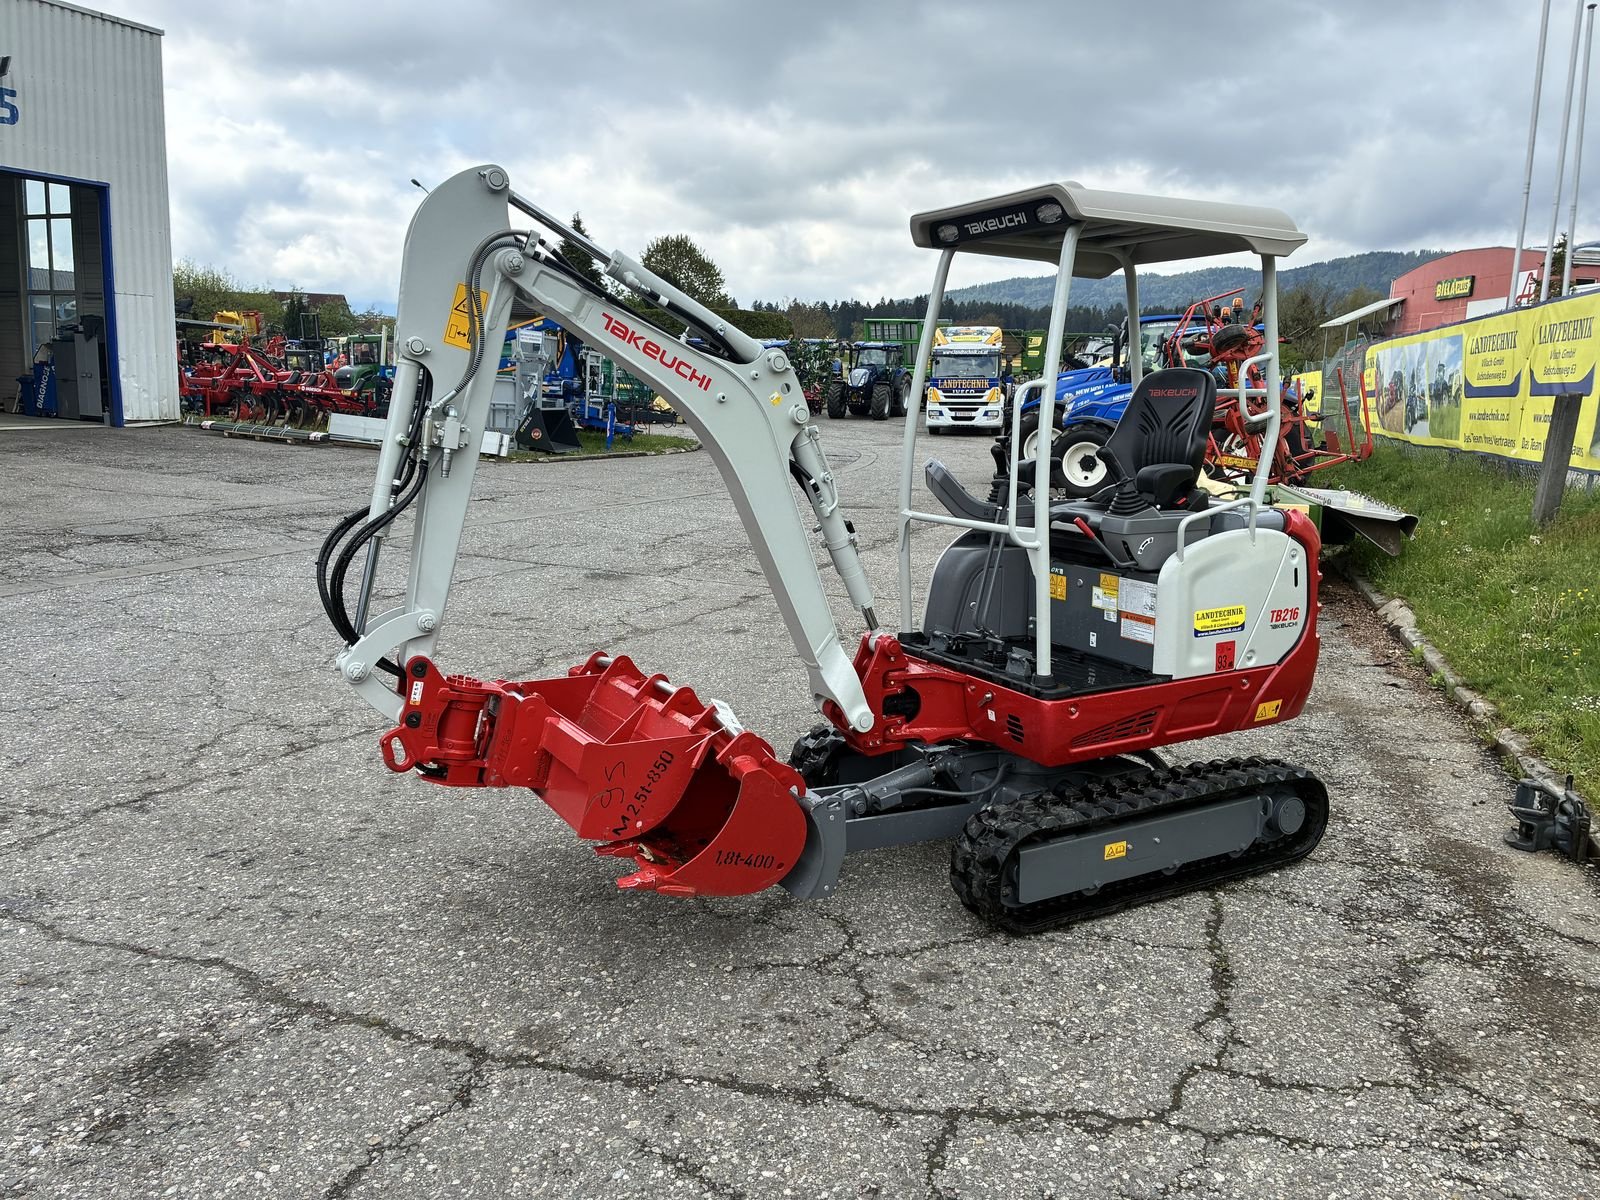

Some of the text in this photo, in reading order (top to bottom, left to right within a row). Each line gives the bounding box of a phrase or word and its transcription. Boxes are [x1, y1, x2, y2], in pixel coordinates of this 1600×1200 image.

[964, 211, 1027, 235] TAKEUCHI
[1436, 280, 1456, 297] BILLA
[1538, 316, 1595, 345] LANDTECHNIK
[1469, 330, 1518, 355] LANDTECHNIK
[602, 312, 712, 391] TAKEUCHI
[938, 379, 990, 389] LANDTECHNIK
[1075, 388, 1090, 396] NEW
[1149, 388, 1197, 397] TAKEUCHI
[1196, 607, 1244, 621] LANDTECHNIK
[1270, 607, 1300, 624] TB216
[1269, 621, 1298, 630] TAKEUCHI
[714, 850, 775, 869] 1,8t-400
